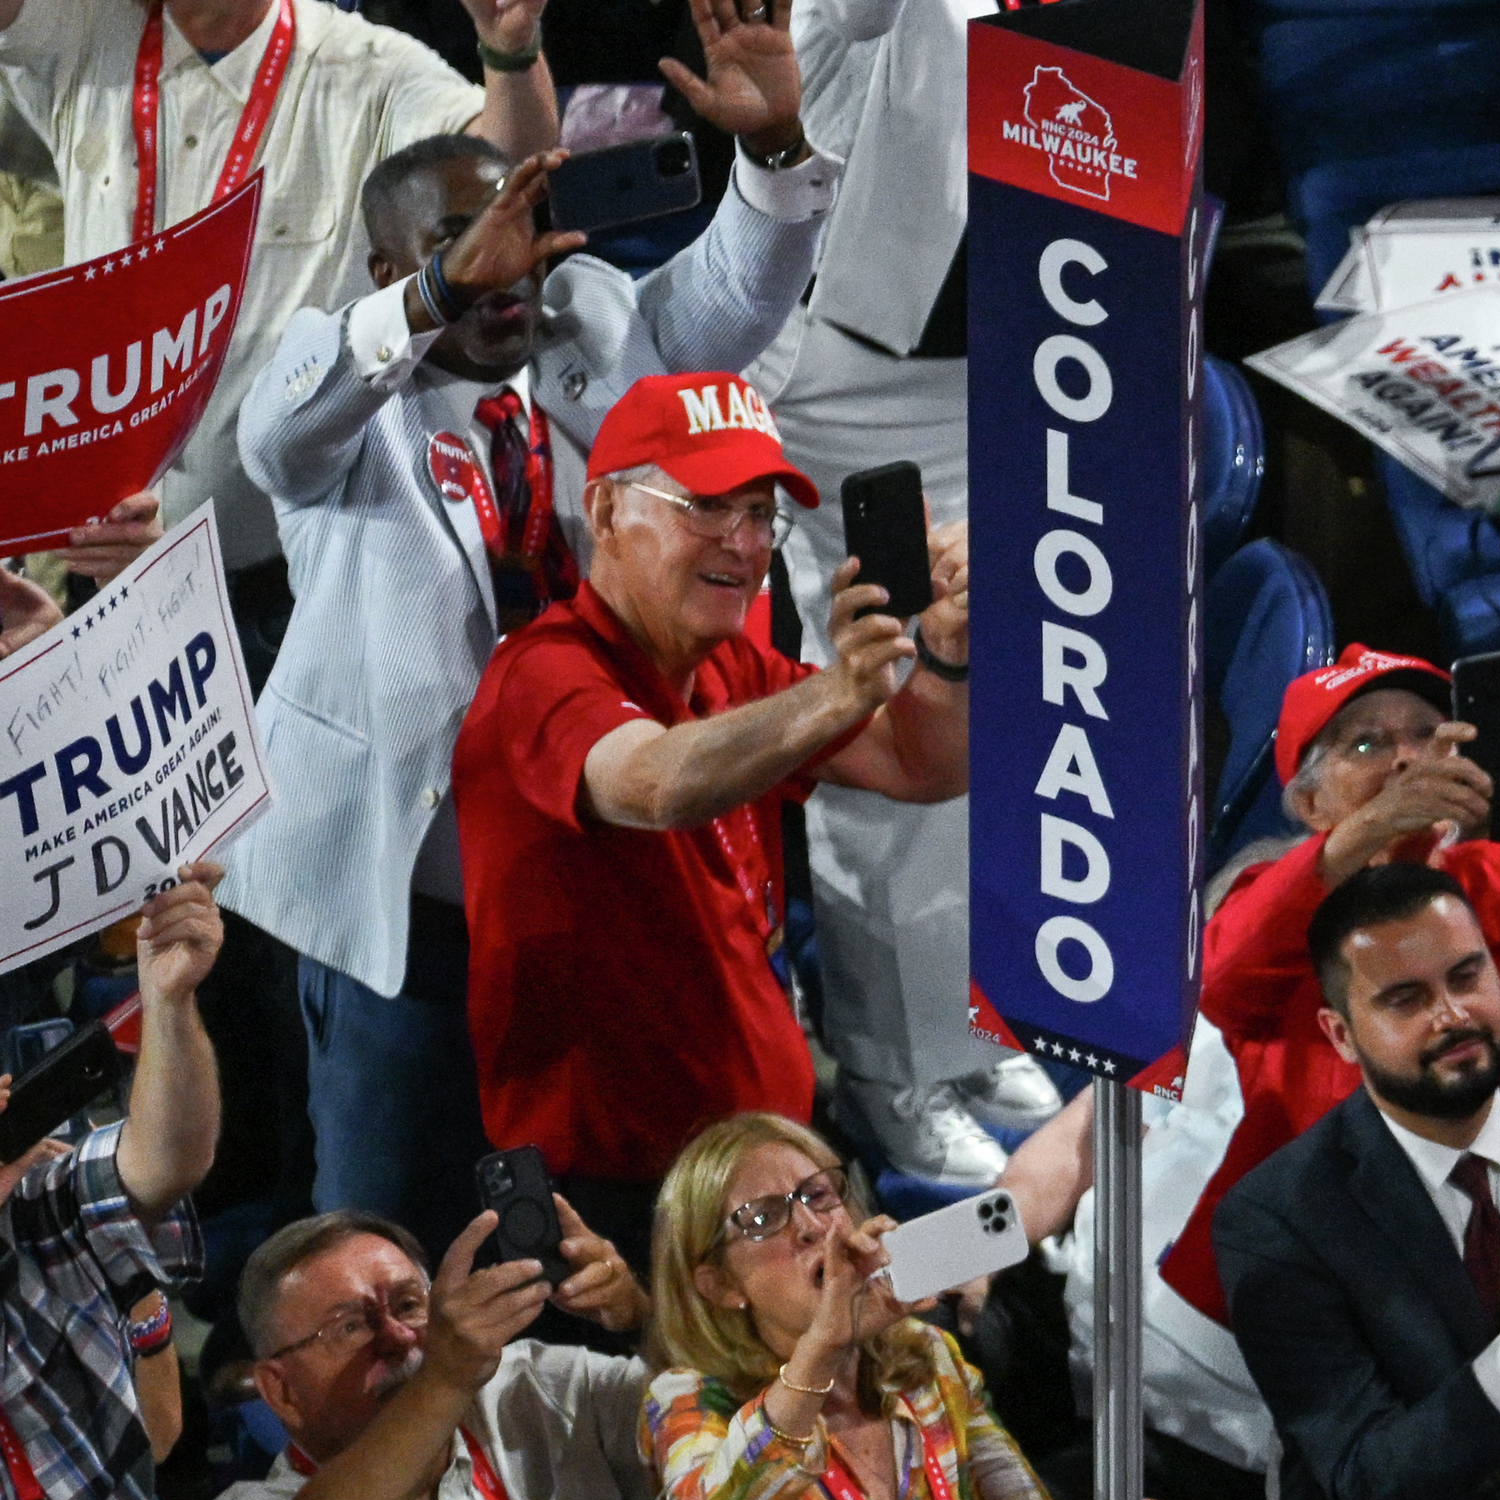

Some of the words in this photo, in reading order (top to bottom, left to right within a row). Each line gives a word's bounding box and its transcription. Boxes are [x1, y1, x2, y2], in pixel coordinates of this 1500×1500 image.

[1002, 119, 1138, 179] MILWAUKEE
[1041, 119, 1066, 136] RNC
[1067, 127, 1100, 147] 2024
[36, 419, 124, 457] AMERICA
[129, 389, 175, 427] GREAT
[1349, 369, 1485, 452] AGAIN!
[1032, 237, 1115, 1004] COLORADO
[0, 631, 217, 839] TRUMP
[24, 826, 77, 863] MAKE
[82, 781, 154, 835] AMERICA
[154, 744, 188, 786] GREAT
[188, 706, 222, 752] AGAIN!
[23, 855, 76, 931] J
[90, 834, 131, 897] D
[135, 730, 246, 865] VANCE
[968, 1025, 1001, 1044] 2024
[1152, 1082, 1180, 1102] RNC
